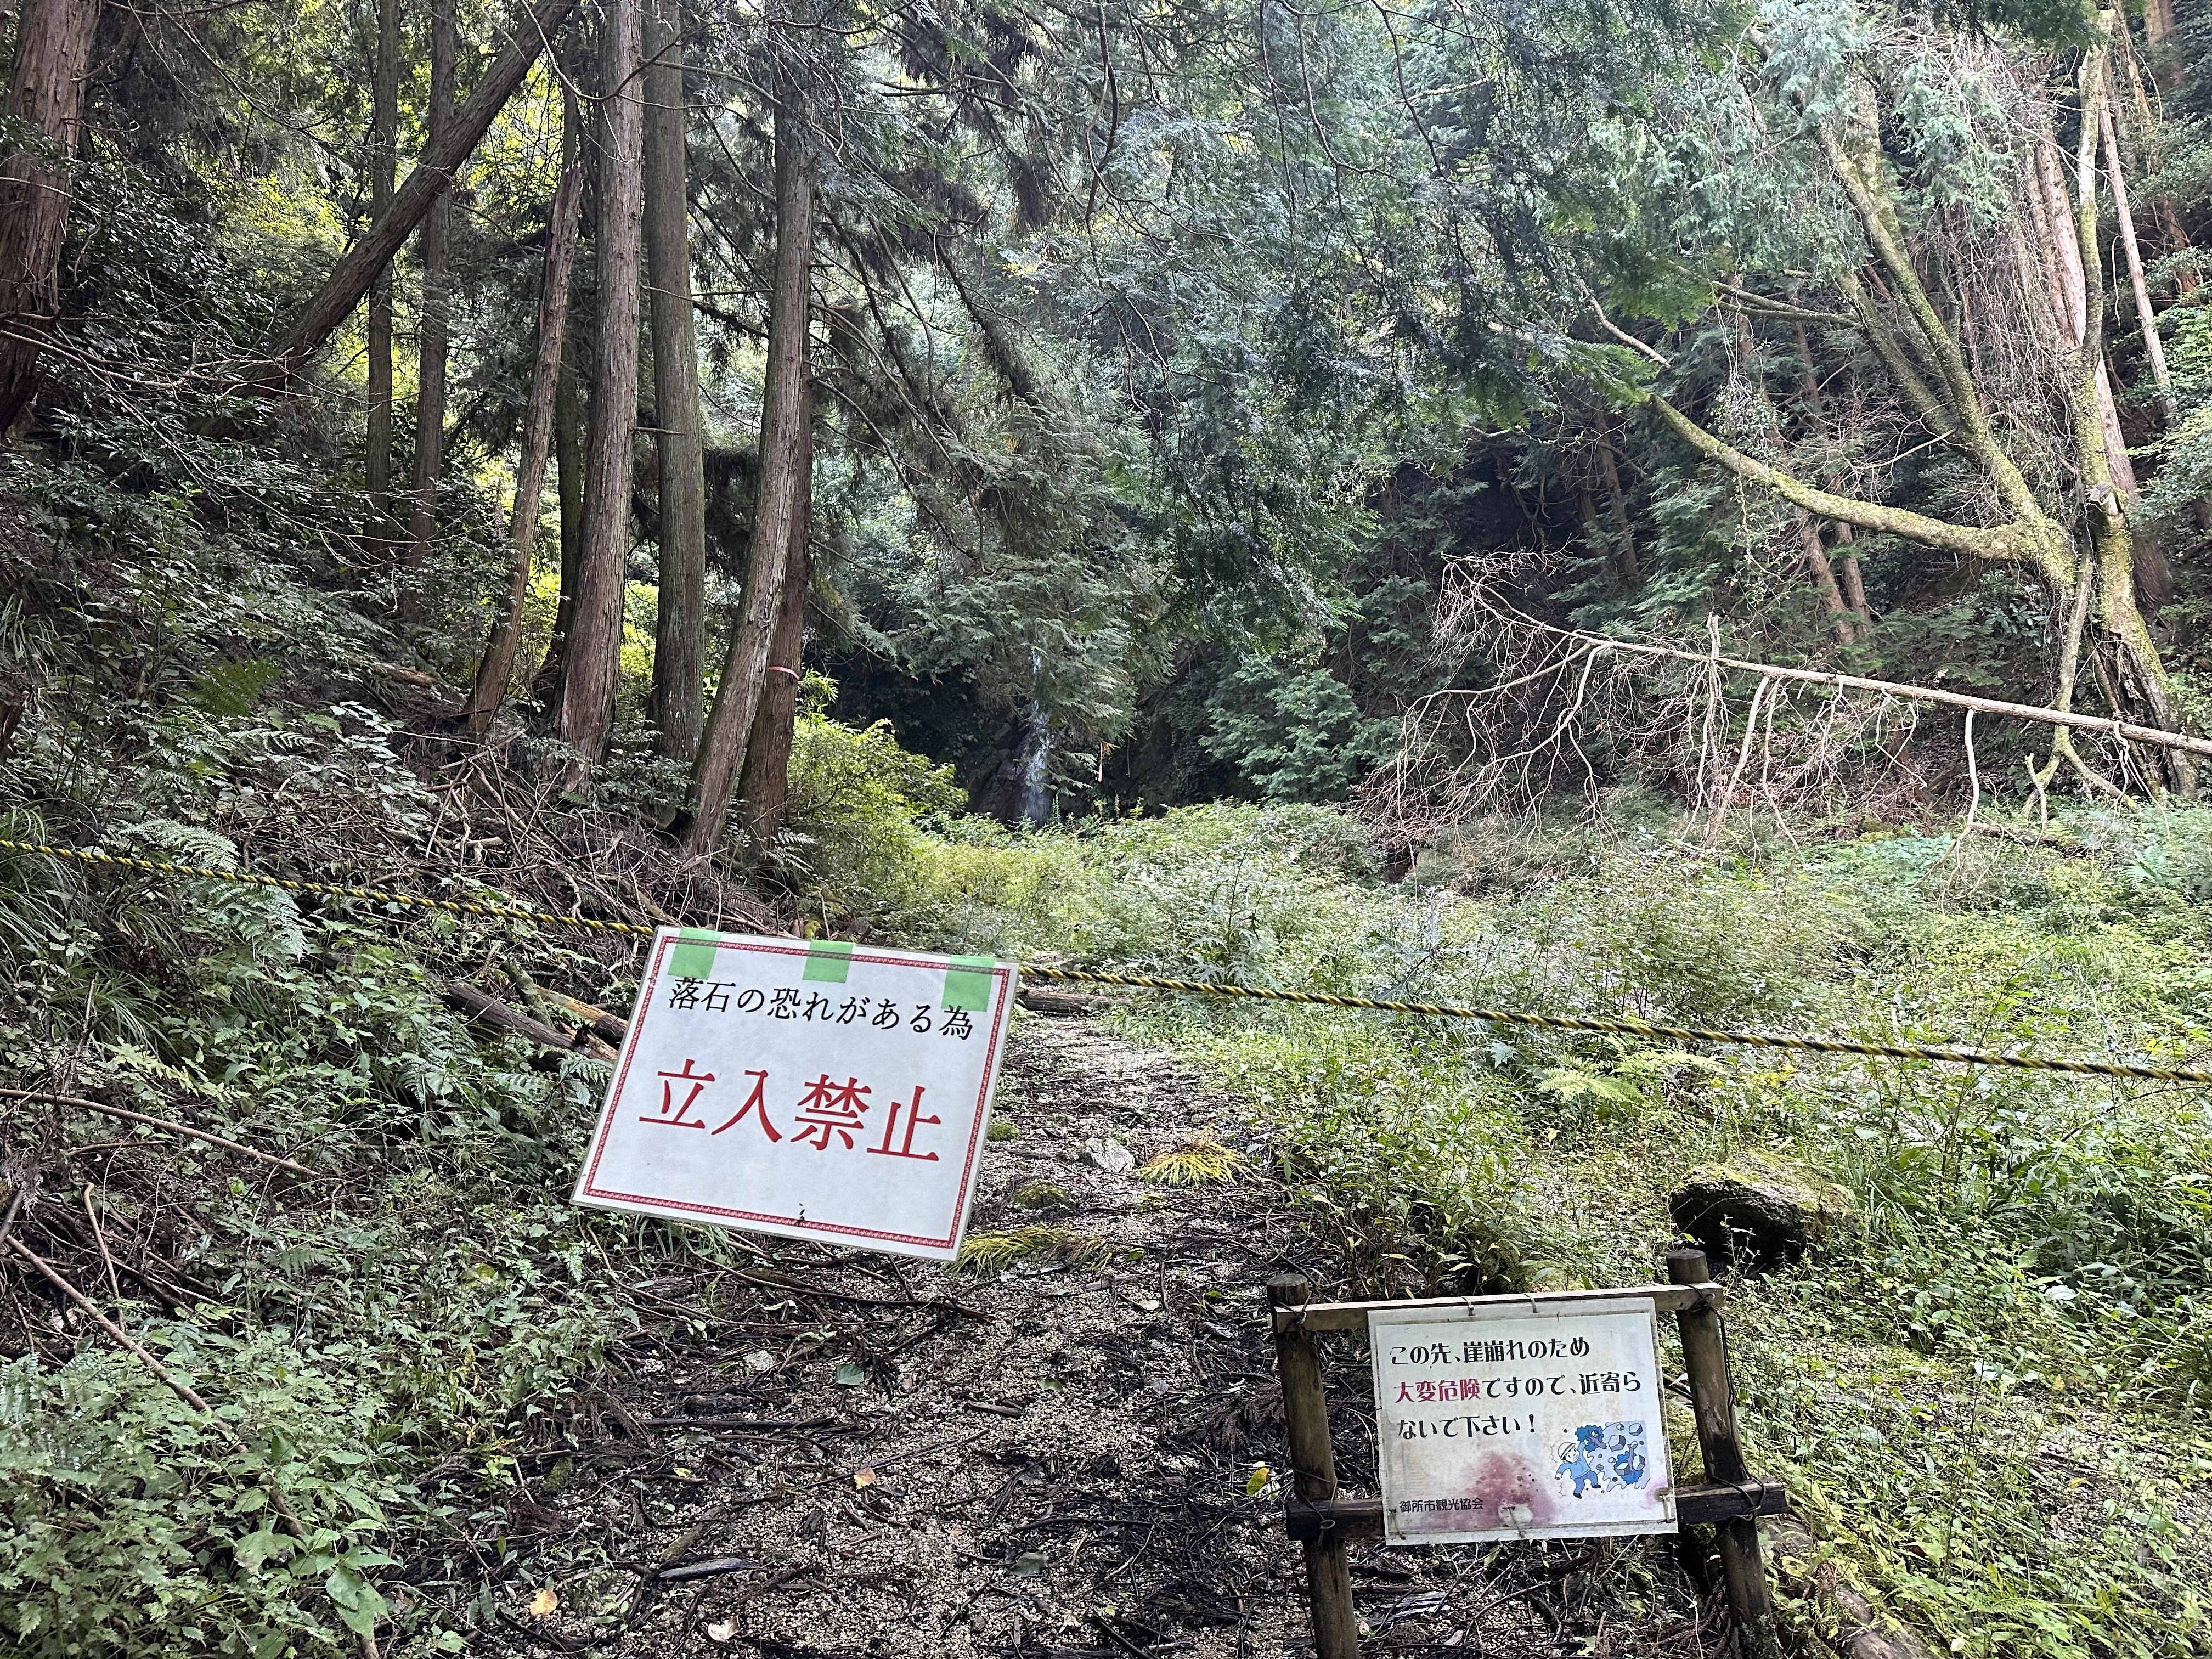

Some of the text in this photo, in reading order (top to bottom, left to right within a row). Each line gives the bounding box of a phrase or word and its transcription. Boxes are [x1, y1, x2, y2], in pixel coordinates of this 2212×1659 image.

[668, 977, 974, 1041] 落石の恐れがある為
[639, 1058, 941, 1162] 立入禁止
[1390, 1336, 1590, 1365] この先、崖崩れのため
[1393, 1370, 1641, 1403] 大変危険ですので、近寄ら
[1398, 1414, 1535, 1440] ないで下さい！
[1399, 1497, 1484, 1513] 御所市観光協会
